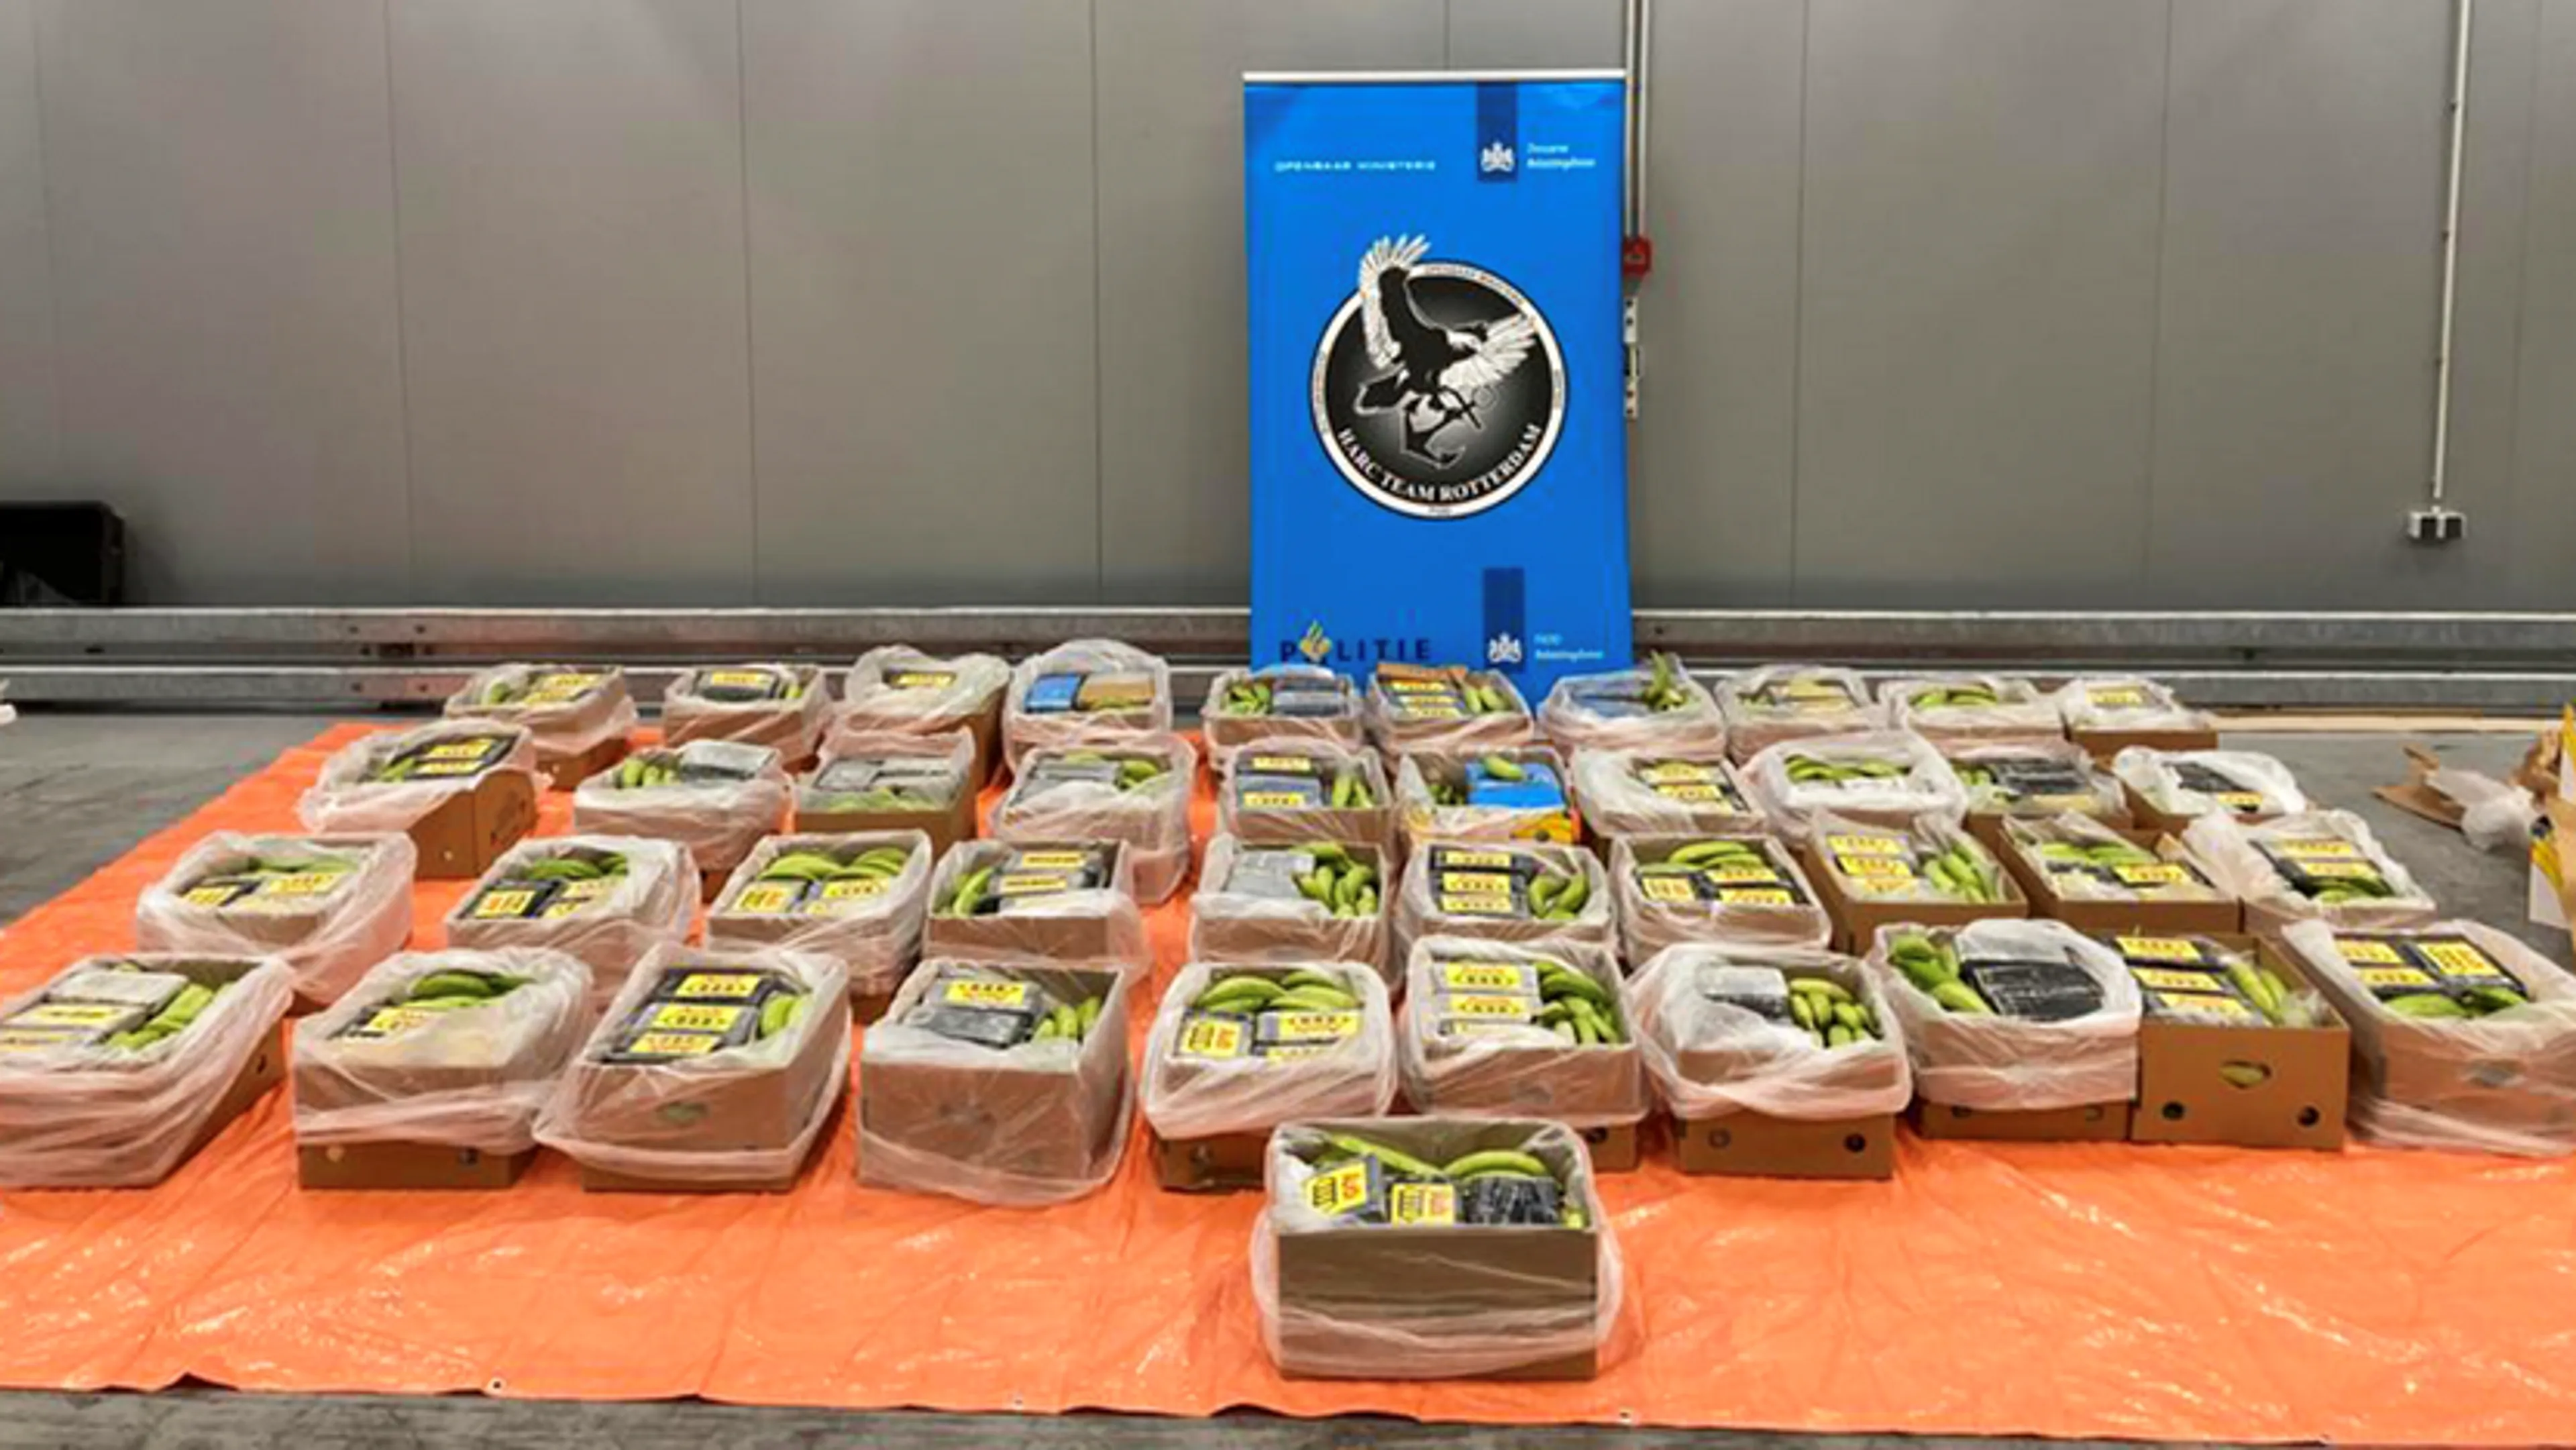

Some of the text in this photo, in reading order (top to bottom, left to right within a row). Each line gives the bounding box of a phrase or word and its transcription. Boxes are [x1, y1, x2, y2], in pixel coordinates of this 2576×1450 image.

[1338, 423, 1542, 501] HARC TEAM ROTTERDAM
